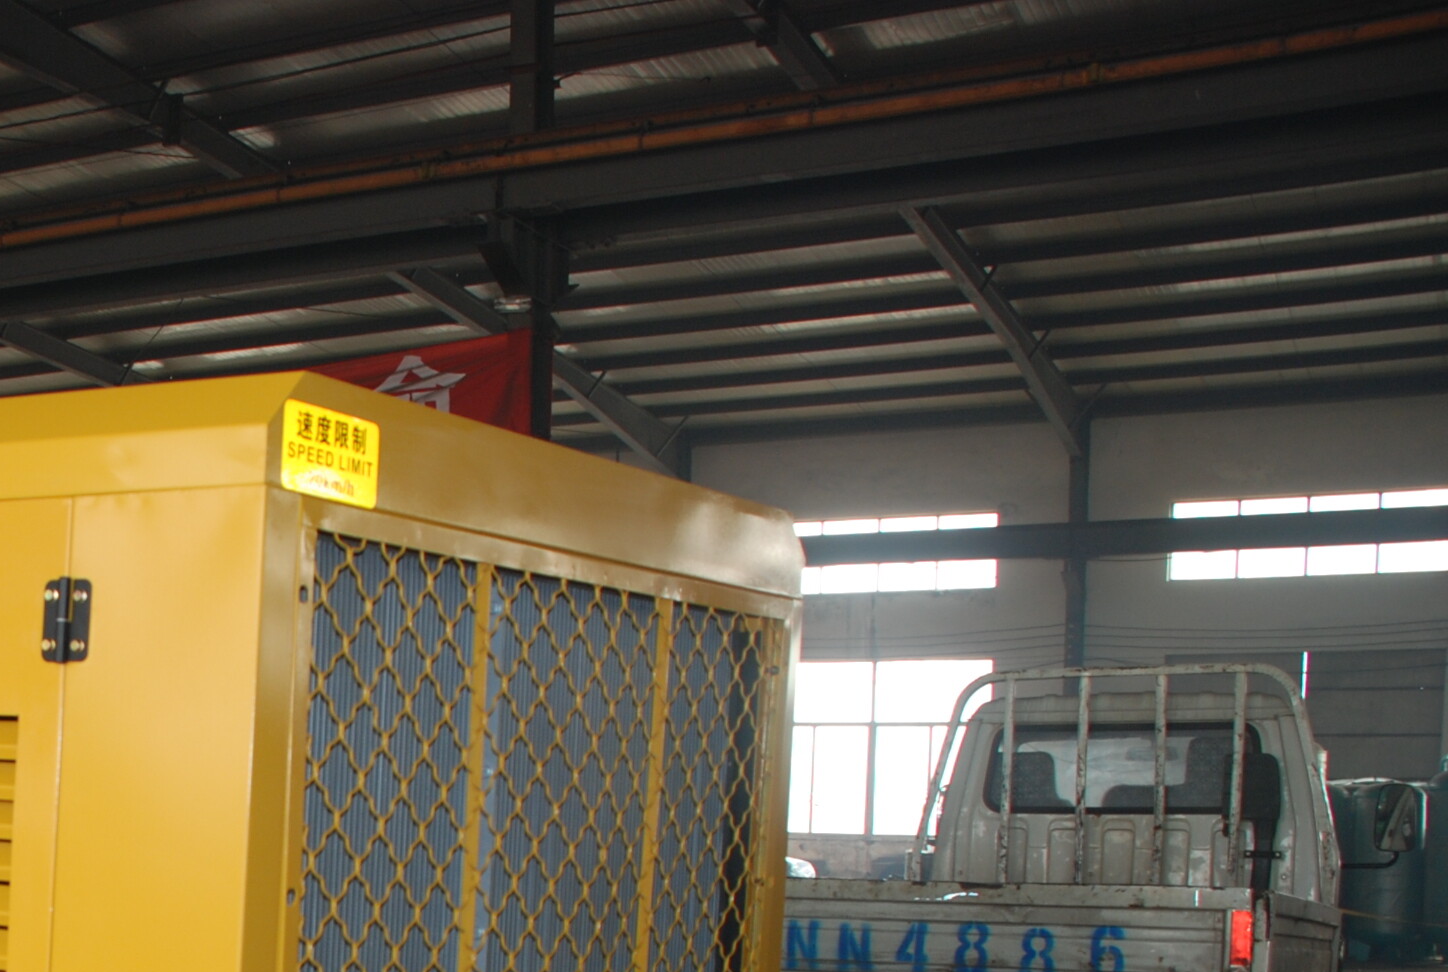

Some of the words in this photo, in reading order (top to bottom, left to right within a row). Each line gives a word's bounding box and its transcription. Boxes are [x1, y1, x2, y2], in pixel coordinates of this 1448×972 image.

[296, 410, 367, 456] 速度限制
[287, 441, 334, 468] SPEED
[338, 453, 373, 478] LIMIT
